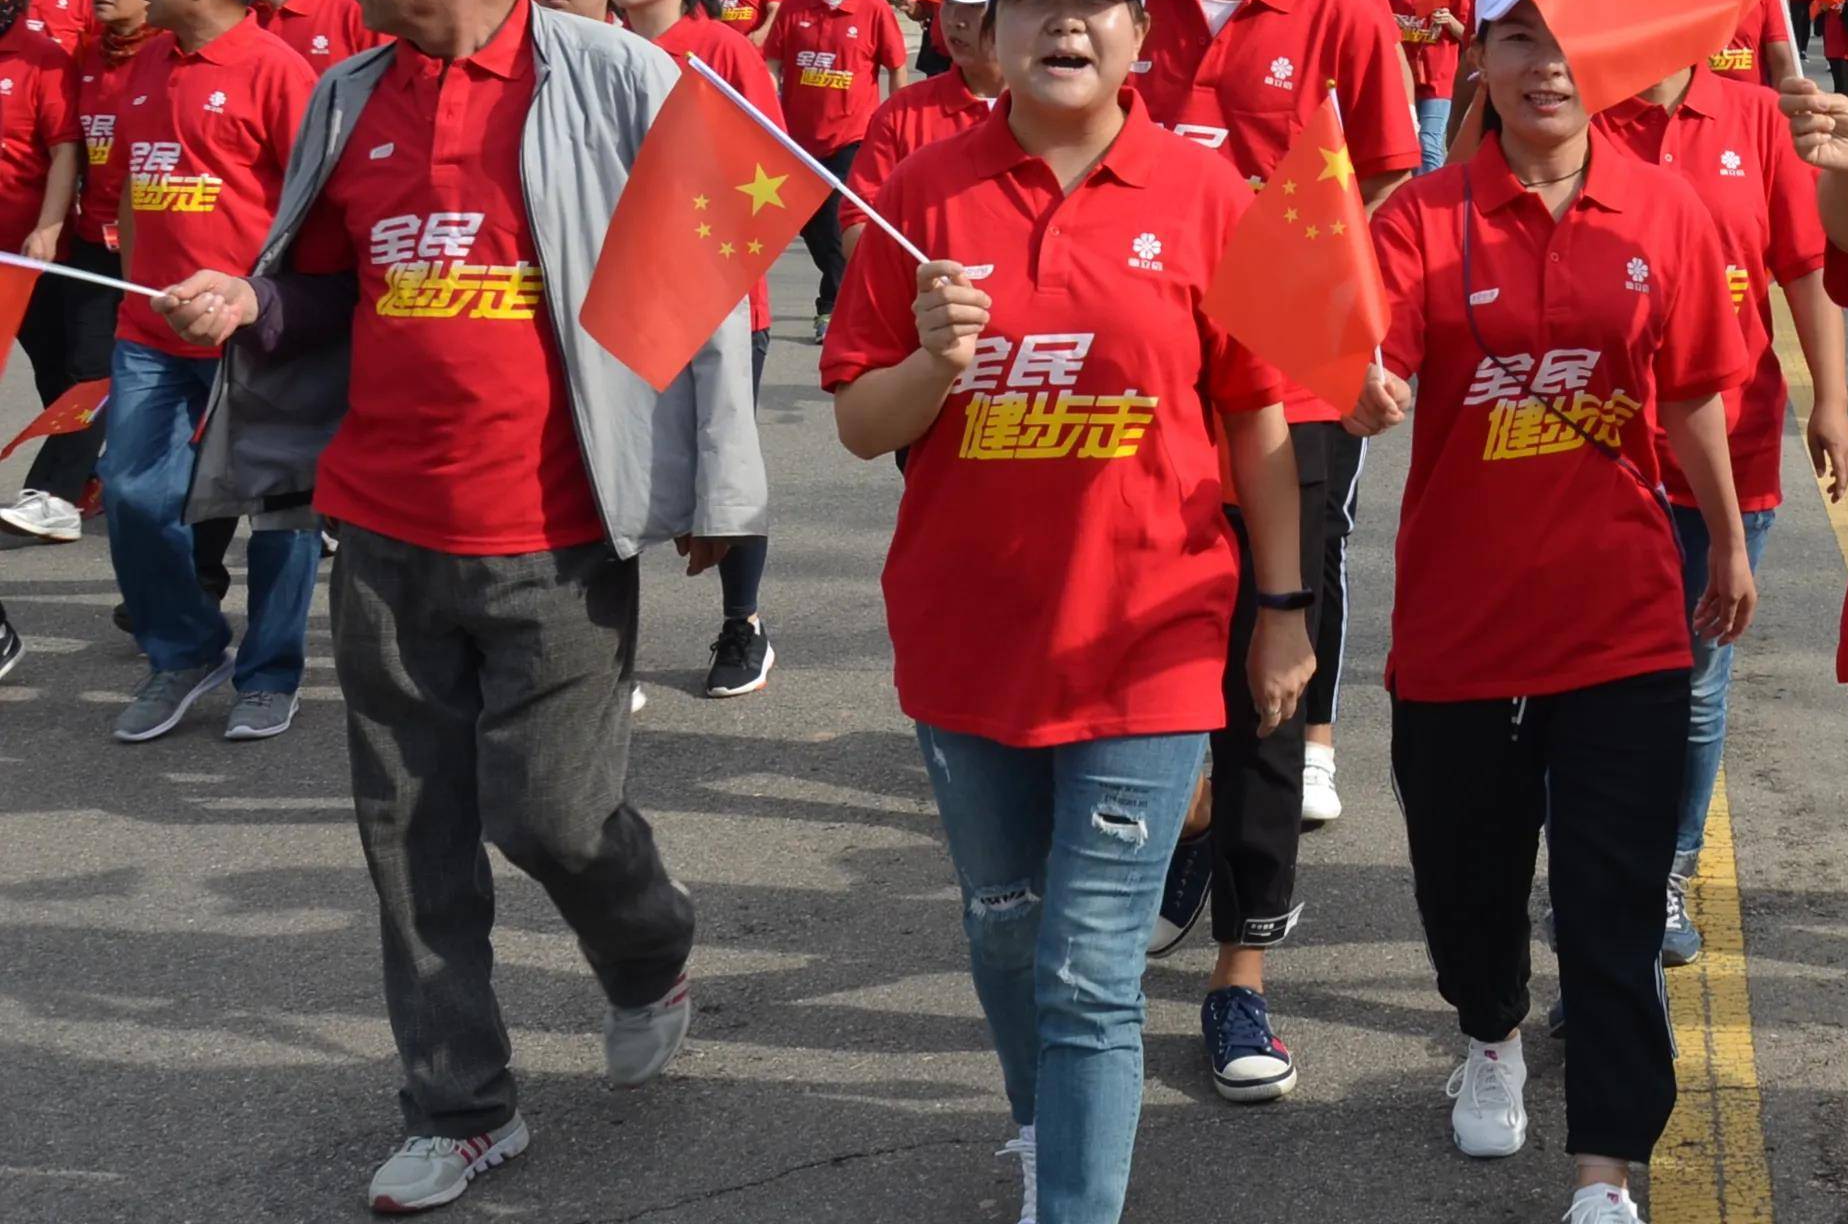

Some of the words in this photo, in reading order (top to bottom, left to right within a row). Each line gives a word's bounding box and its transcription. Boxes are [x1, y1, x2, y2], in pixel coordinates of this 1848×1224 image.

[370, 212, 485, 265] 全民
[376, 260, 545, 319] 健步走
[950, 333, 1095, 395] 全民
[1463, 348, 1601, 406] 全民
[959, 389, 1159, 460] 健步走
